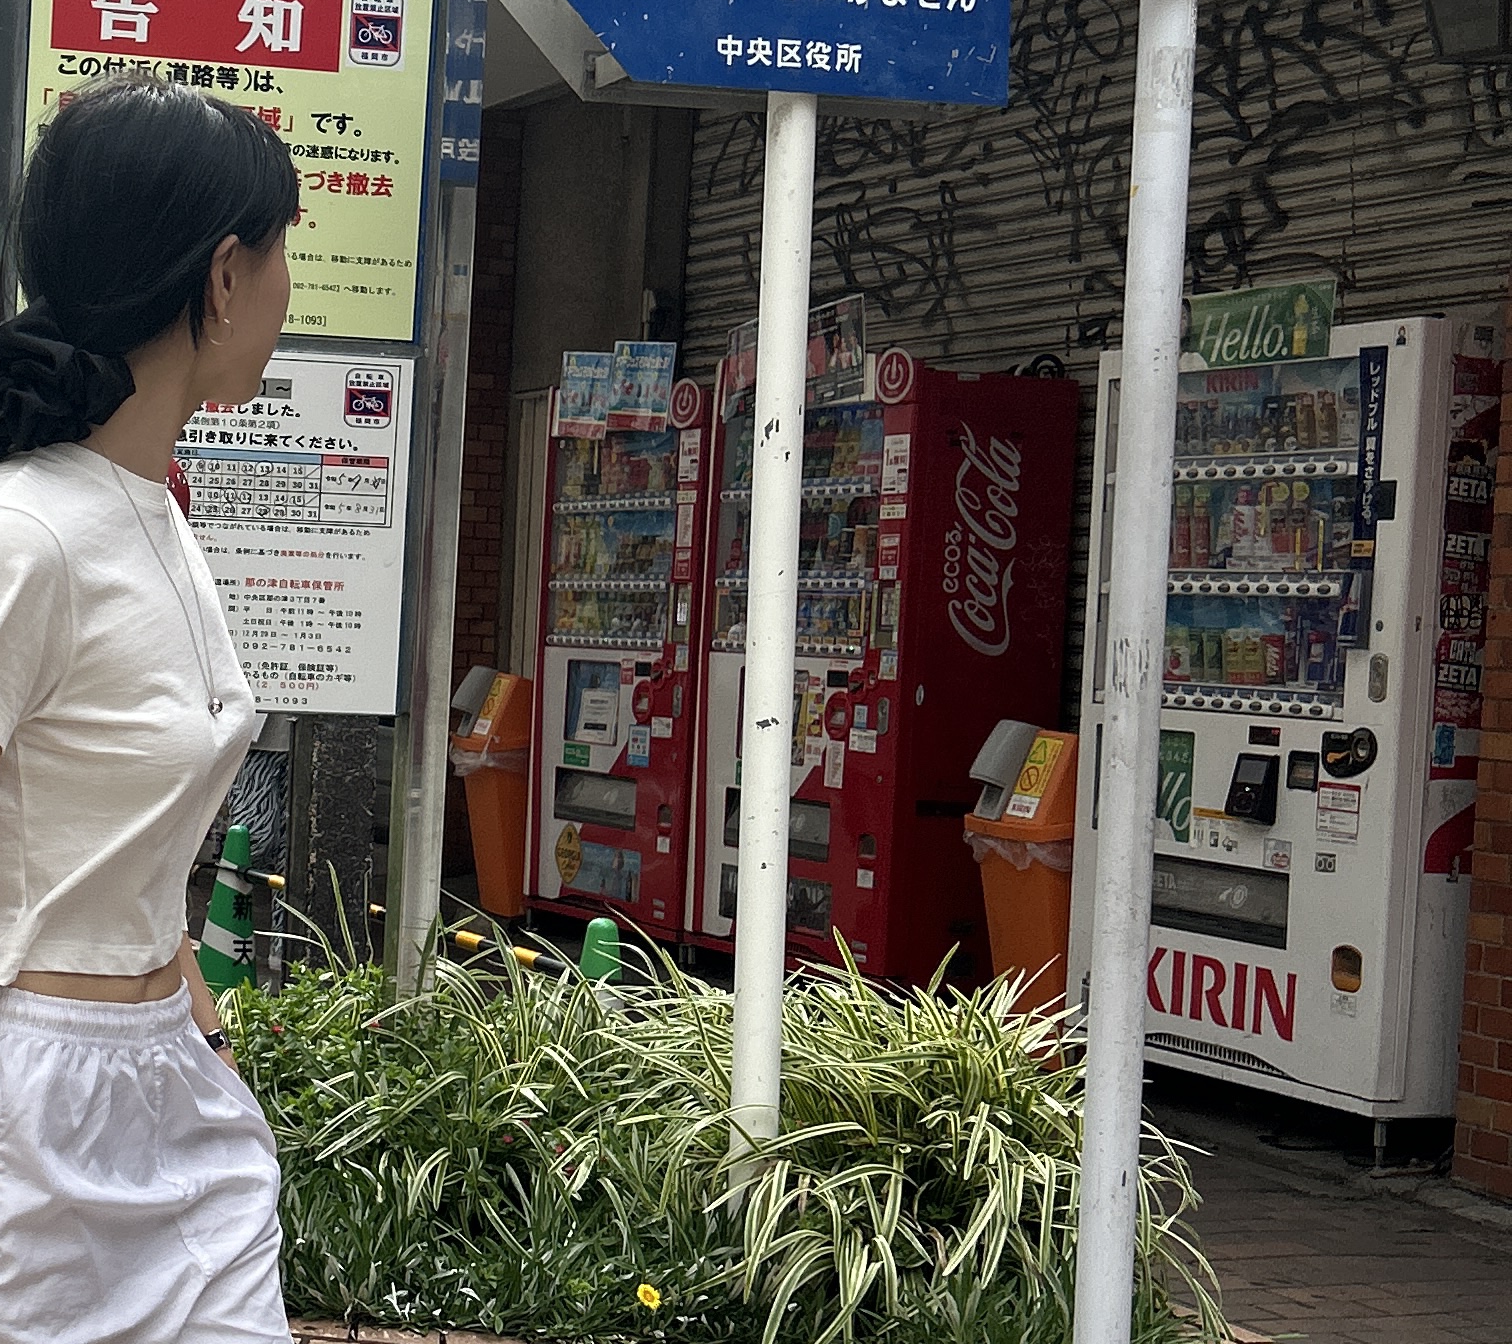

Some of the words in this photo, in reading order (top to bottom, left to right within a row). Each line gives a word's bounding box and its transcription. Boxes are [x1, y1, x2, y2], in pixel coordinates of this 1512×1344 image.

[717, 34, 863, 74] 中央区役所
[1200, 305, 1288, 362] Hello.
